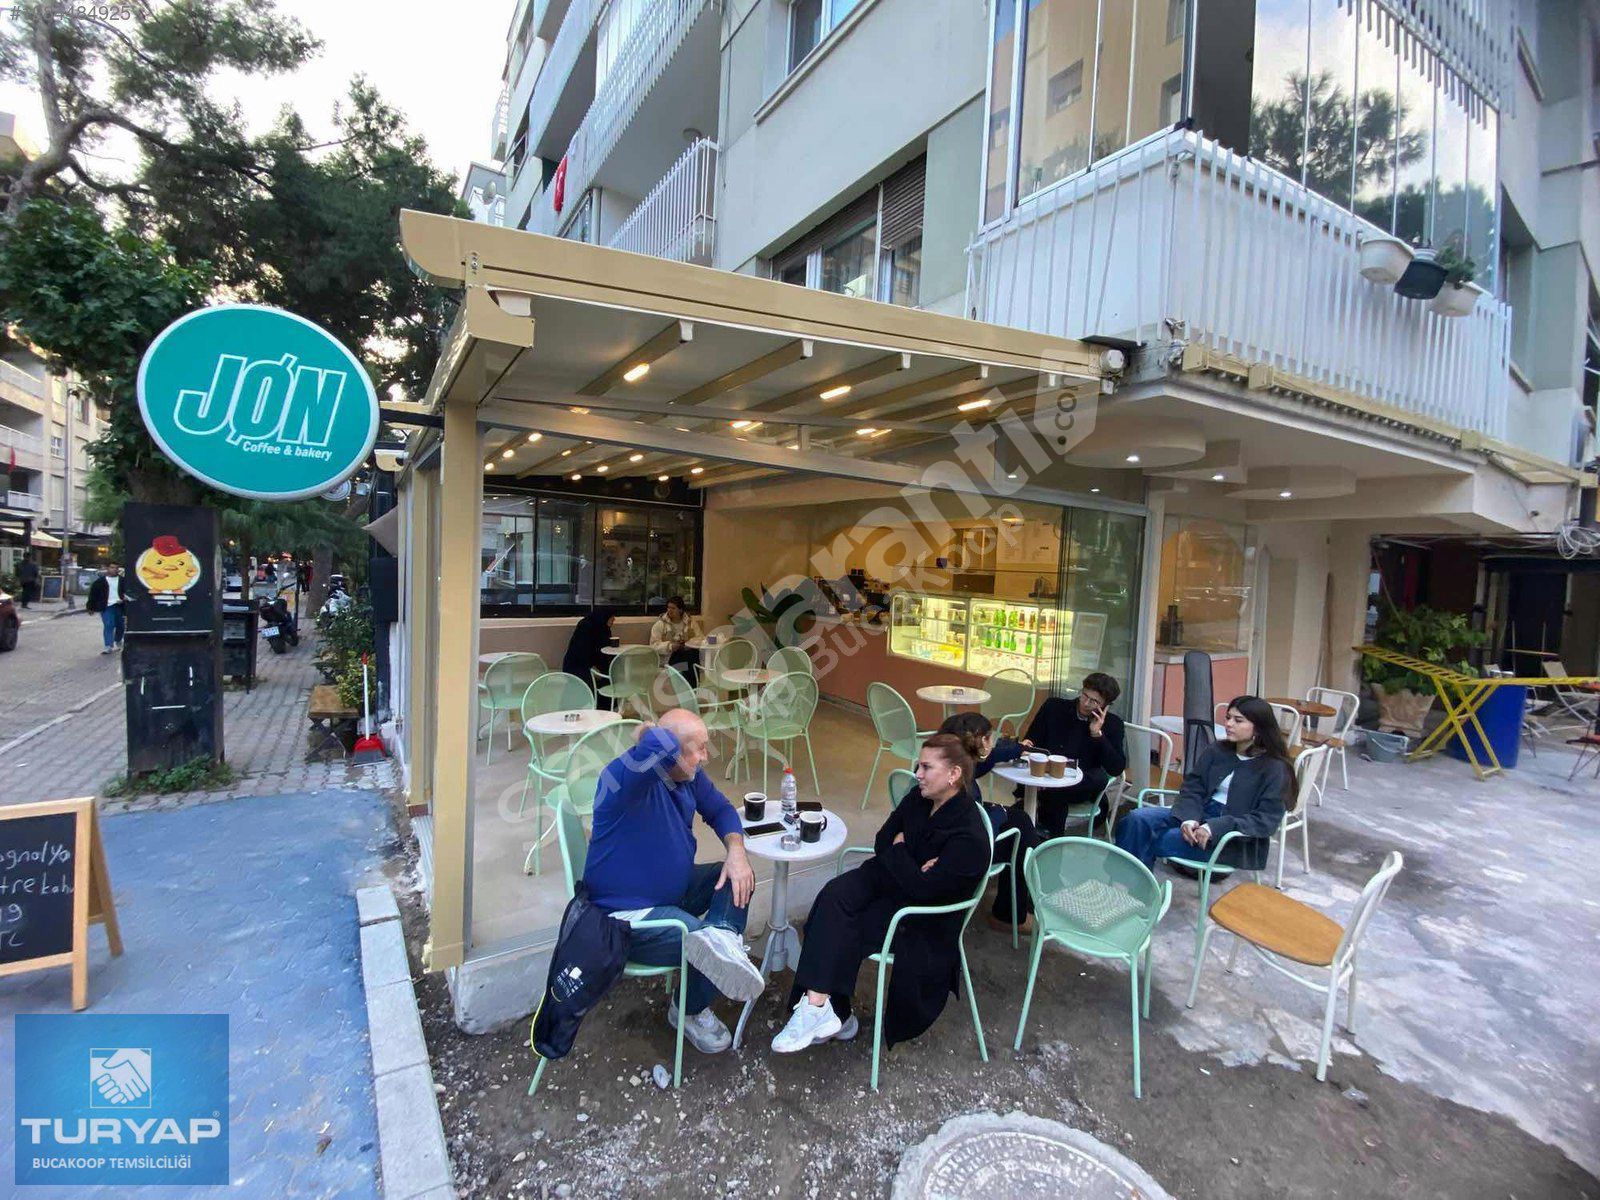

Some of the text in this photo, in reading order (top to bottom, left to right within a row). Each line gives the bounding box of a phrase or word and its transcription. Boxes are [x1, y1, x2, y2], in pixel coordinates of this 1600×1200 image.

[242, 440, 333, 462] Coffee & bakery
